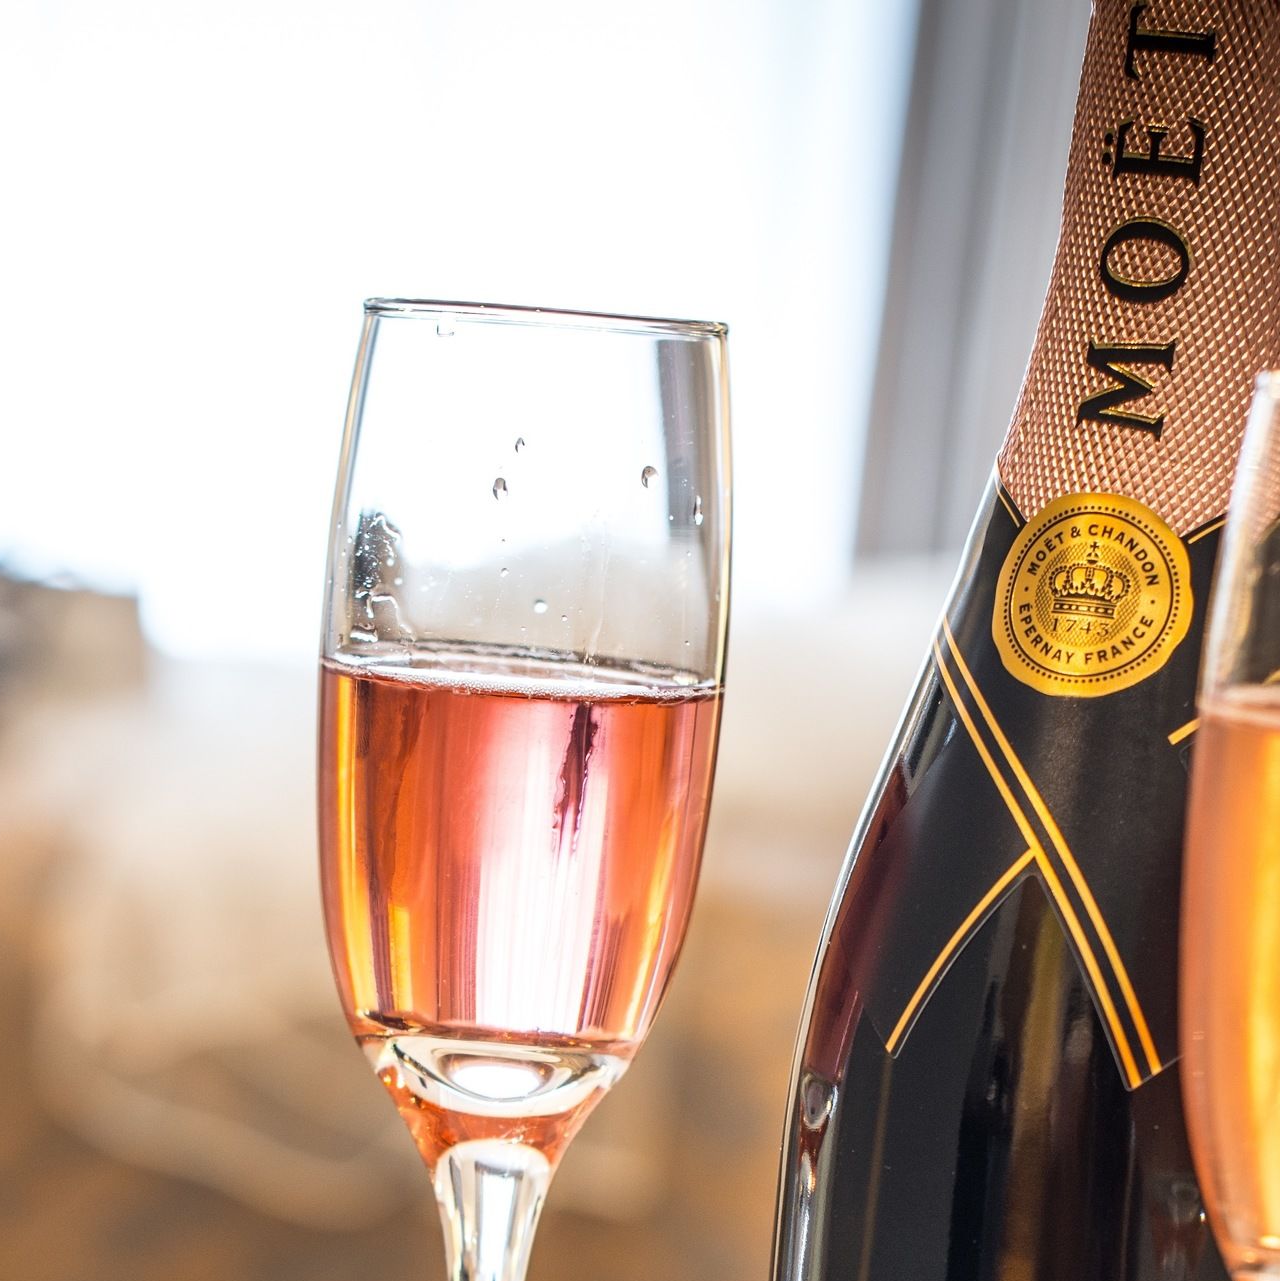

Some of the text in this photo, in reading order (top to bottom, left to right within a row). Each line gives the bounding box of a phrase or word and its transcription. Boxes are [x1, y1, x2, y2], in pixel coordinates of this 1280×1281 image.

[1076, 5, 1217, 441] MOËT
[1027, 524, 1160, 587] MOËT & CHANDON
[1019, 602, 1154, 665] ÉPERNAY FRANCE
[1051, 617, 1110, 638] 1743
